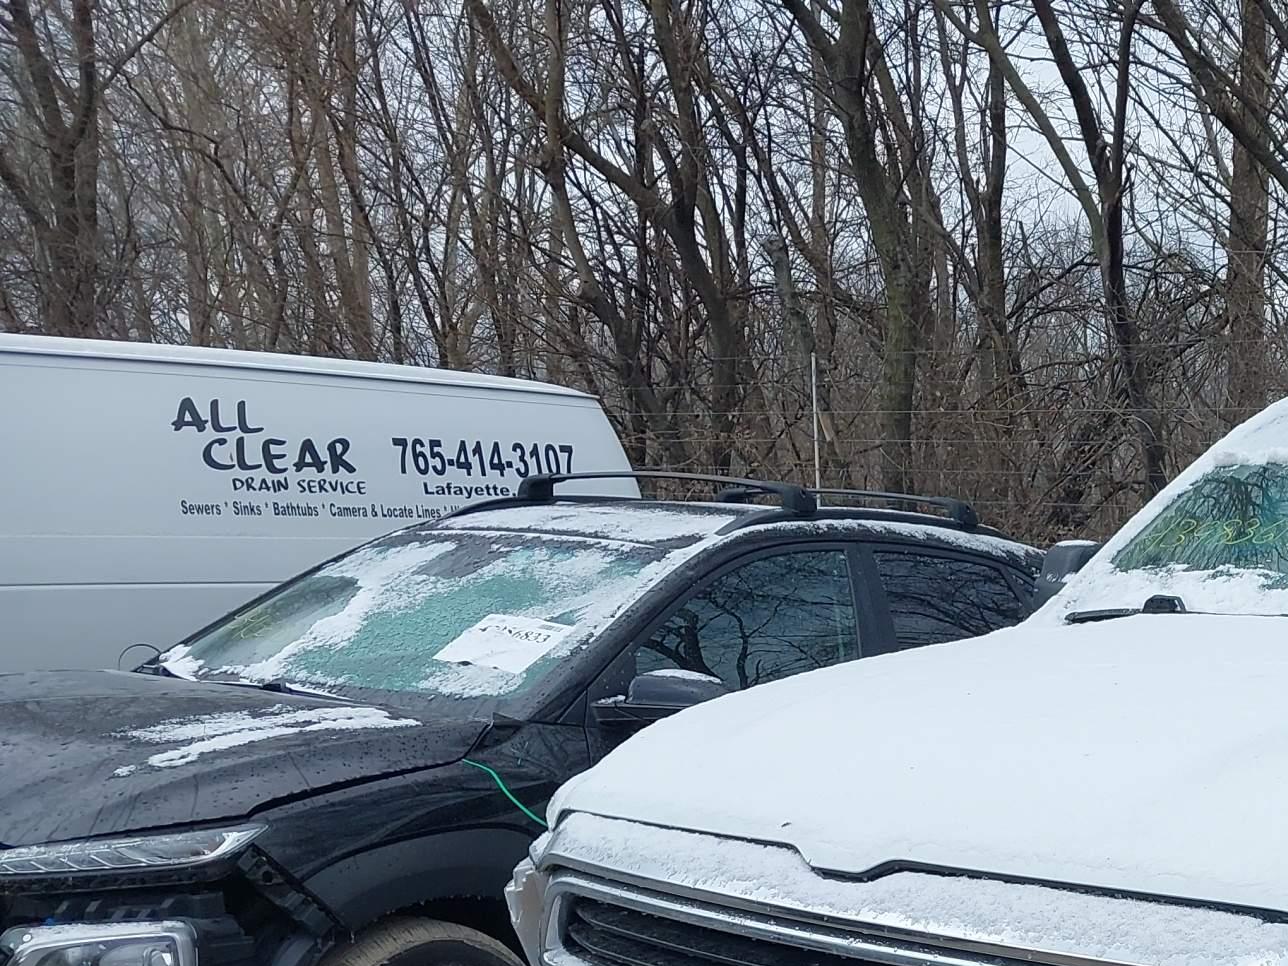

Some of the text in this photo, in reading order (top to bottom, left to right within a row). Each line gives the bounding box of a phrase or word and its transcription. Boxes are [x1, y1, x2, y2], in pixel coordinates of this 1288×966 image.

[171, 397, 264, 433] ALL
[202, 436, 357, 474] CLEAR
[392, 437, 573, 478] 765-414-3107
[232, 477, 366, 495] DRAIN SERVICE
[181, 500, 222, 515] Sewers
[232, 500, 262, 516] Sinks
[272, 502, 319, 517] Bathtubs
[329, 503, 368, 517] Camera
[371, 504, 378, 518] &
[380, 504, 414, 519] Locate
[416, 504, 442, 519] Lines
